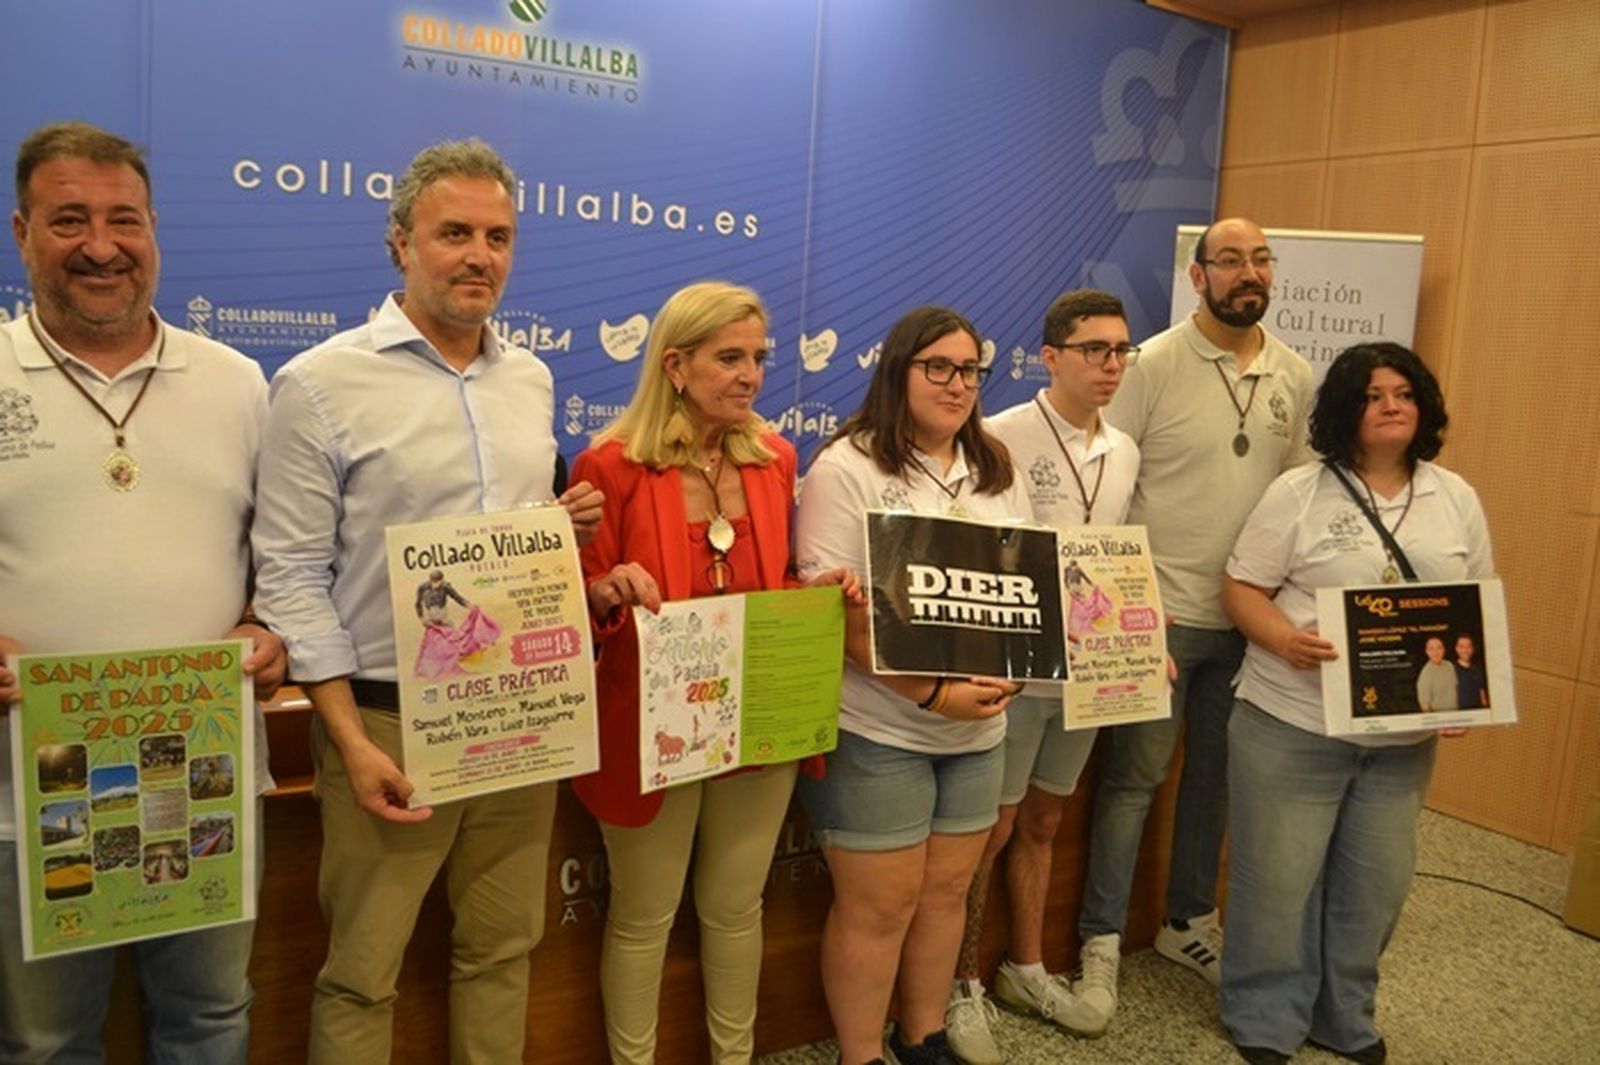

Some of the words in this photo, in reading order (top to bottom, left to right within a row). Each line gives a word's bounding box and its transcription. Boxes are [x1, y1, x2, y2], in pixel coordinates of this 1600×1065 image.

[402, 14, 638, 78] COLLADOVILLALBA
[403, 55, 638, 104] AYUNTAMIENTO
[217, 307, 337, 326] COLLADOVILLALBA
[1276, 308, 1386, 337] Cultural
[404, 542, 485, 571] Collado
[491, 530, 563, 558] Villalba
[1060, 540, 1098, 558] ollado
[906, 564, 1039, 605] DIER
[28, 661, 93, 685] SAN
[100, 650, 234, 681] ANTONIO
[447, 678, 494, 701] CLASE
[499, 664, 570, 693] PRÁCTICA
[60, 692, 102, 714] DE
[109, 683, 213, 710] PADUA
[686, 677, 730, 703] 2025
[83, 708, 194, 741] 2025
[412, 715, 452, 732] Samuel
[456, 706, 508, 725] Montero
[519, 696, 558, 713] Manuel
[559, 691, 587, 706] Vega
